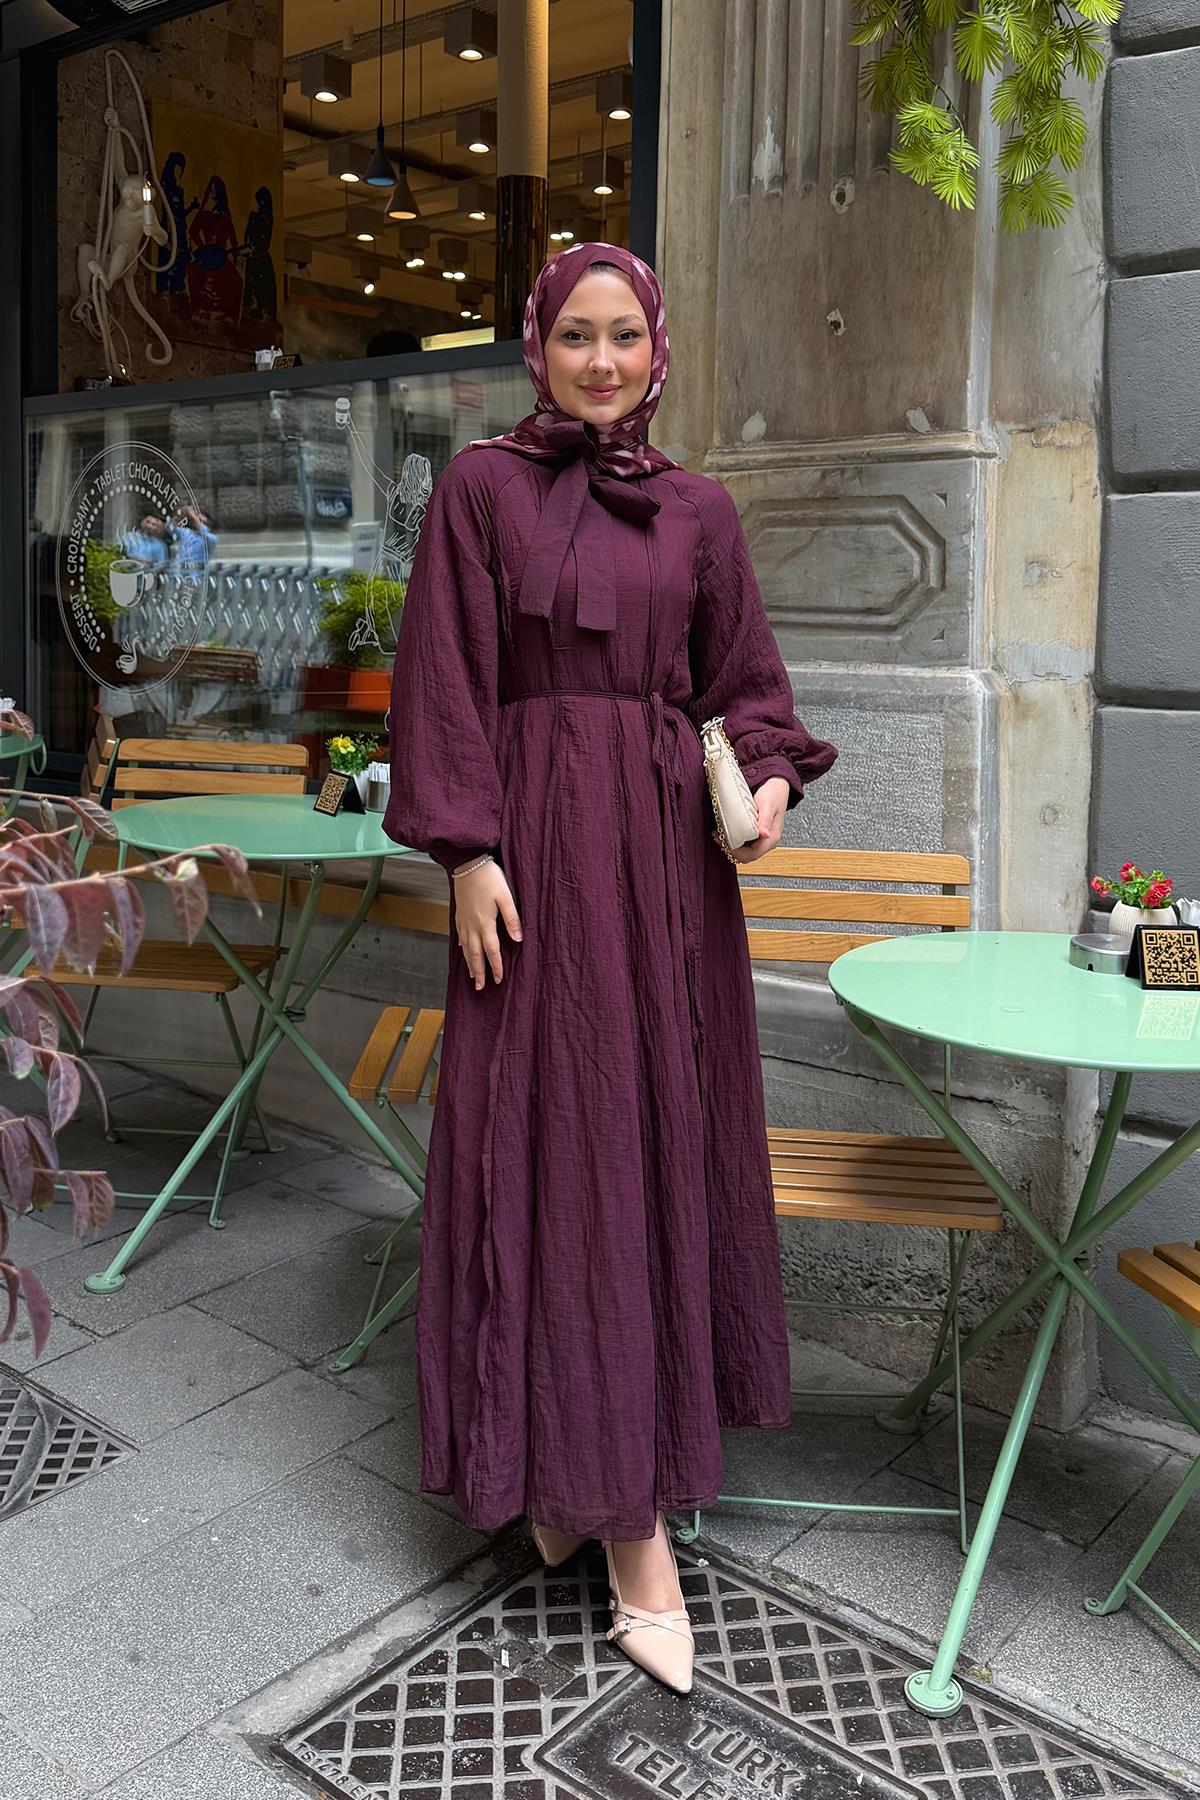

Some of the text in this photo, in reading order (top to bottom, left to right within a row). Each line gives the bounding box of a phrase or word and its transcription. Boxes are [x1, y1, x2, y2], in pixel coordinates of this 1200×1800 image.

[94, 463, 127, 491] TABLET
[128, 462, 180, 511] CHOCOLATE
[67, 496, 92, 574] CROISSANT
[70, 594, 98, 651] DESSERT
[163, 575, 195, 656] CHOCOLATE
[614, 1733, 738, 1800] TELE
[687, 1717, 803, 1798] TÜRK
